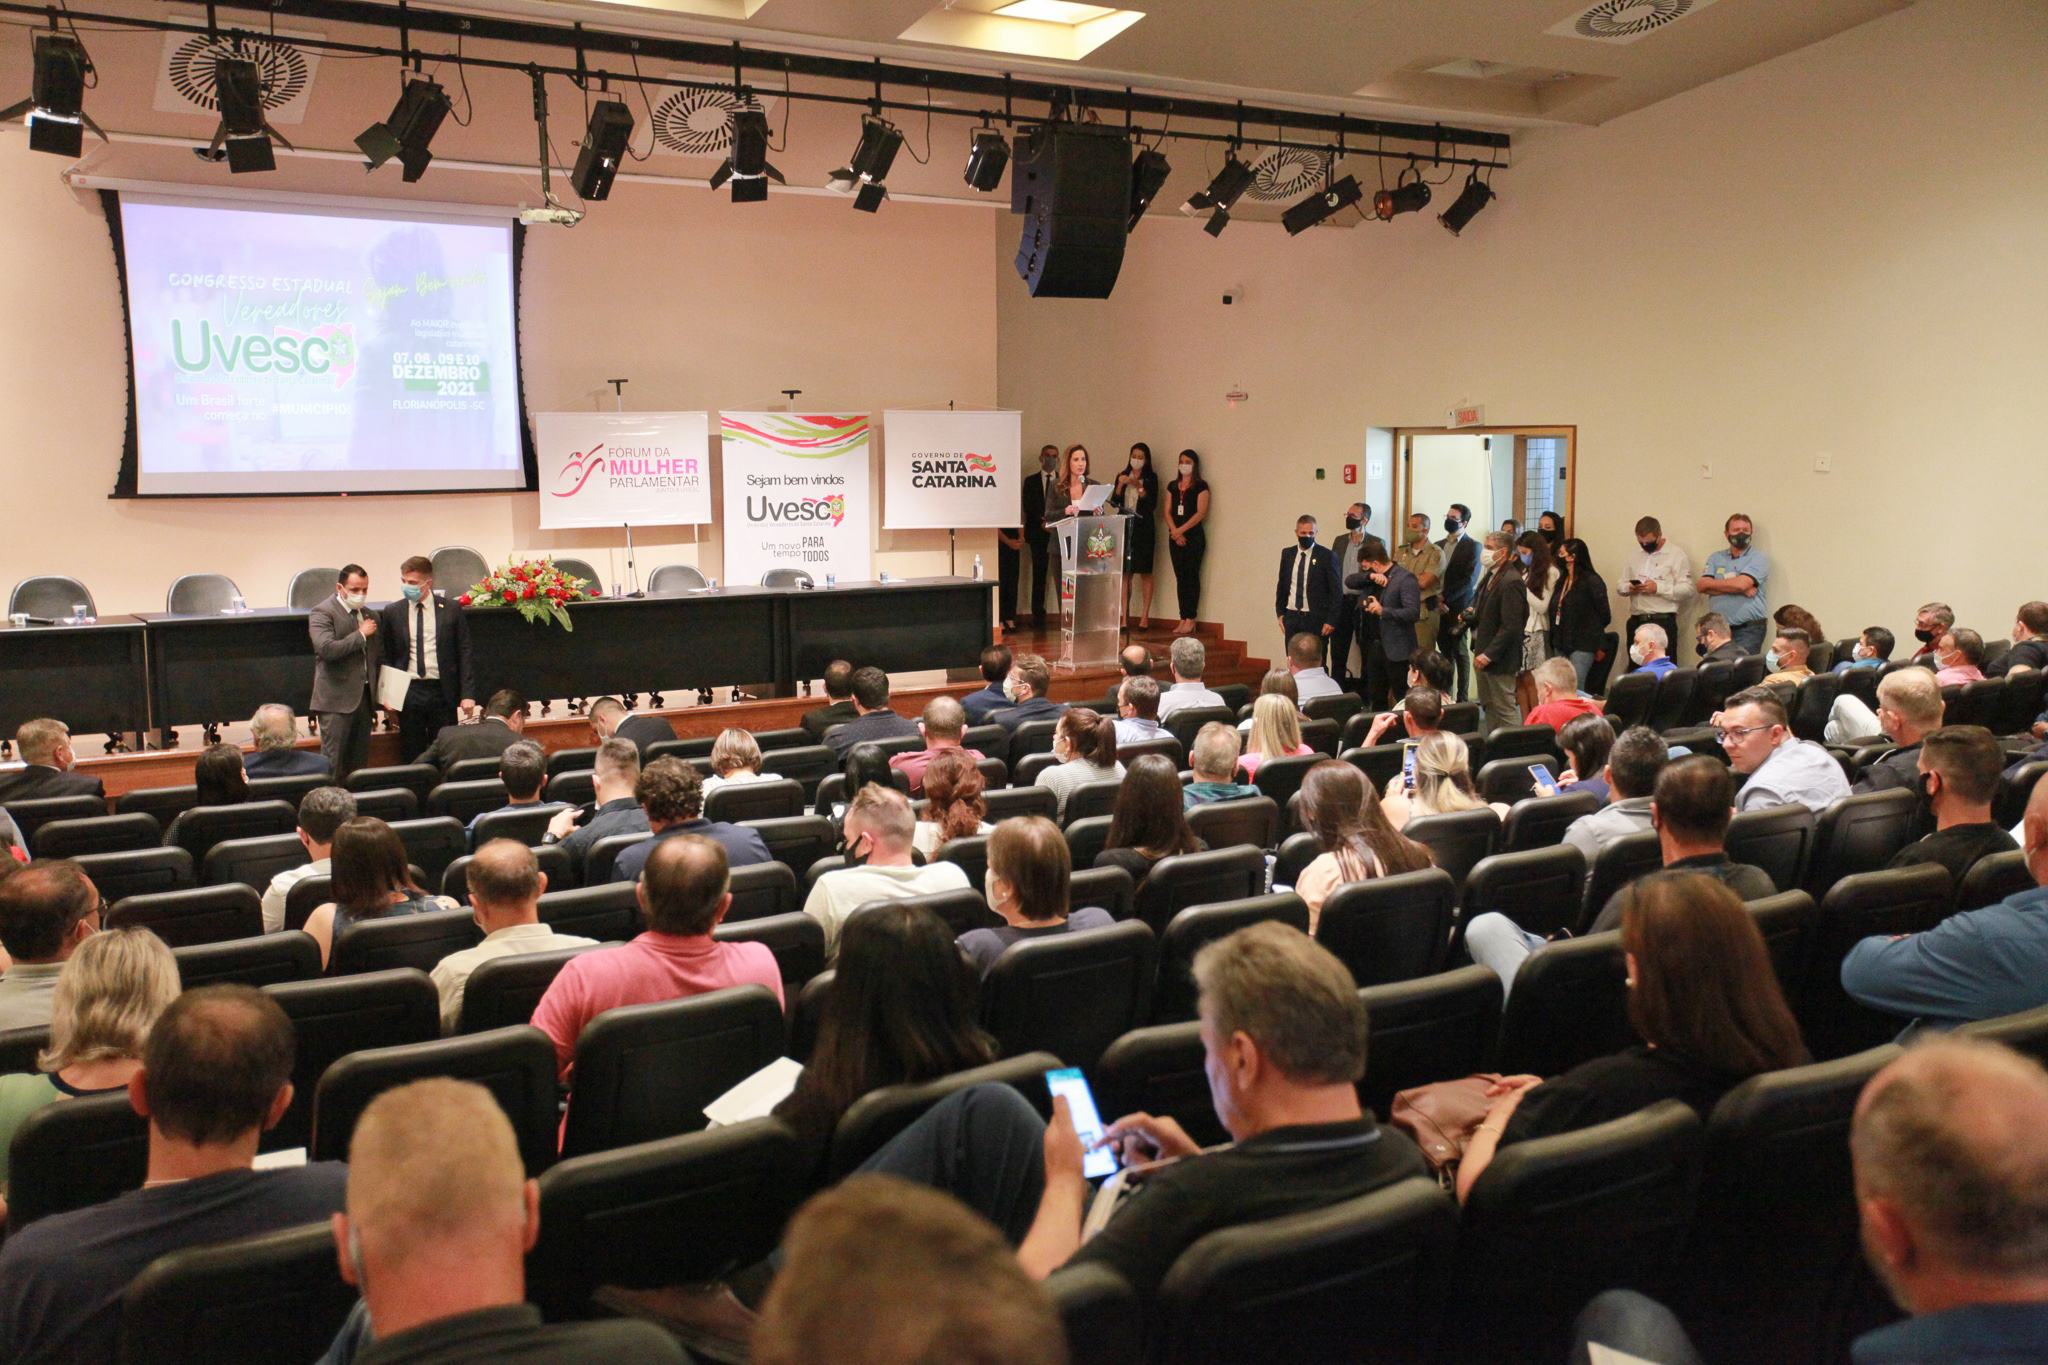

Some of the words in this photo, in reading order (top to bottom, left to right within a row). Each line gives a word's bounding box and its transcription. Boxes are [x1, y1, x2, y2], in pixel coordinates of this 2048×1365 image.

[168, 273, 266, 290] CONGRESSO
[272, 278, 352, 294] ESTADUAL
[222, 286, 348, 330] Vereadores
[410, 319, 422, 328] Ao
[422, 319, 449, 328] MAIOR
[414, 328, 450, 338] legislativo
[170, 318, 331, 374] Uvesc
[438, 353, 454, 365] 09
[456, 354, 464, 366] E
[465, 354, 480, 366] 10
[392, 364, 480, 380] DEZEMBRO
[437, 381, 476, 396] 2021
[176, 394, 197, 406] Um
[200, 394, 234, 406] Brasil
[236, 395, 265, 406] forte
[392, 398, 467, 410] FLORIANÓPOLIS
[272, 401, 352, 416] #MUNICÍPIO!
[203, 411, 247, 423] começa
[251, 411, 266, 421] no
[608, 445, 651, 458] FÓRUM
[654, 447, 671, 458] DA
[610, 458, 698, 476] MULHER
[912, 460, 968, 474] SANTA
[610, 476, 700, 488] PARLAMENTAR
[746, 474, 781, 488] Sejam
[784, 474, 808, 486] bem
[810, 474, 845, 485] vindos
[912, 476, 997, 488] CATARINA
[746, 495, 831, 522] Uvesc
[762, 542, 776, 550] Um
[802, 536, 825, 548] PARA
[773, 550, 801, 558] tempo
[802, 550, 829, 562] TODOS
